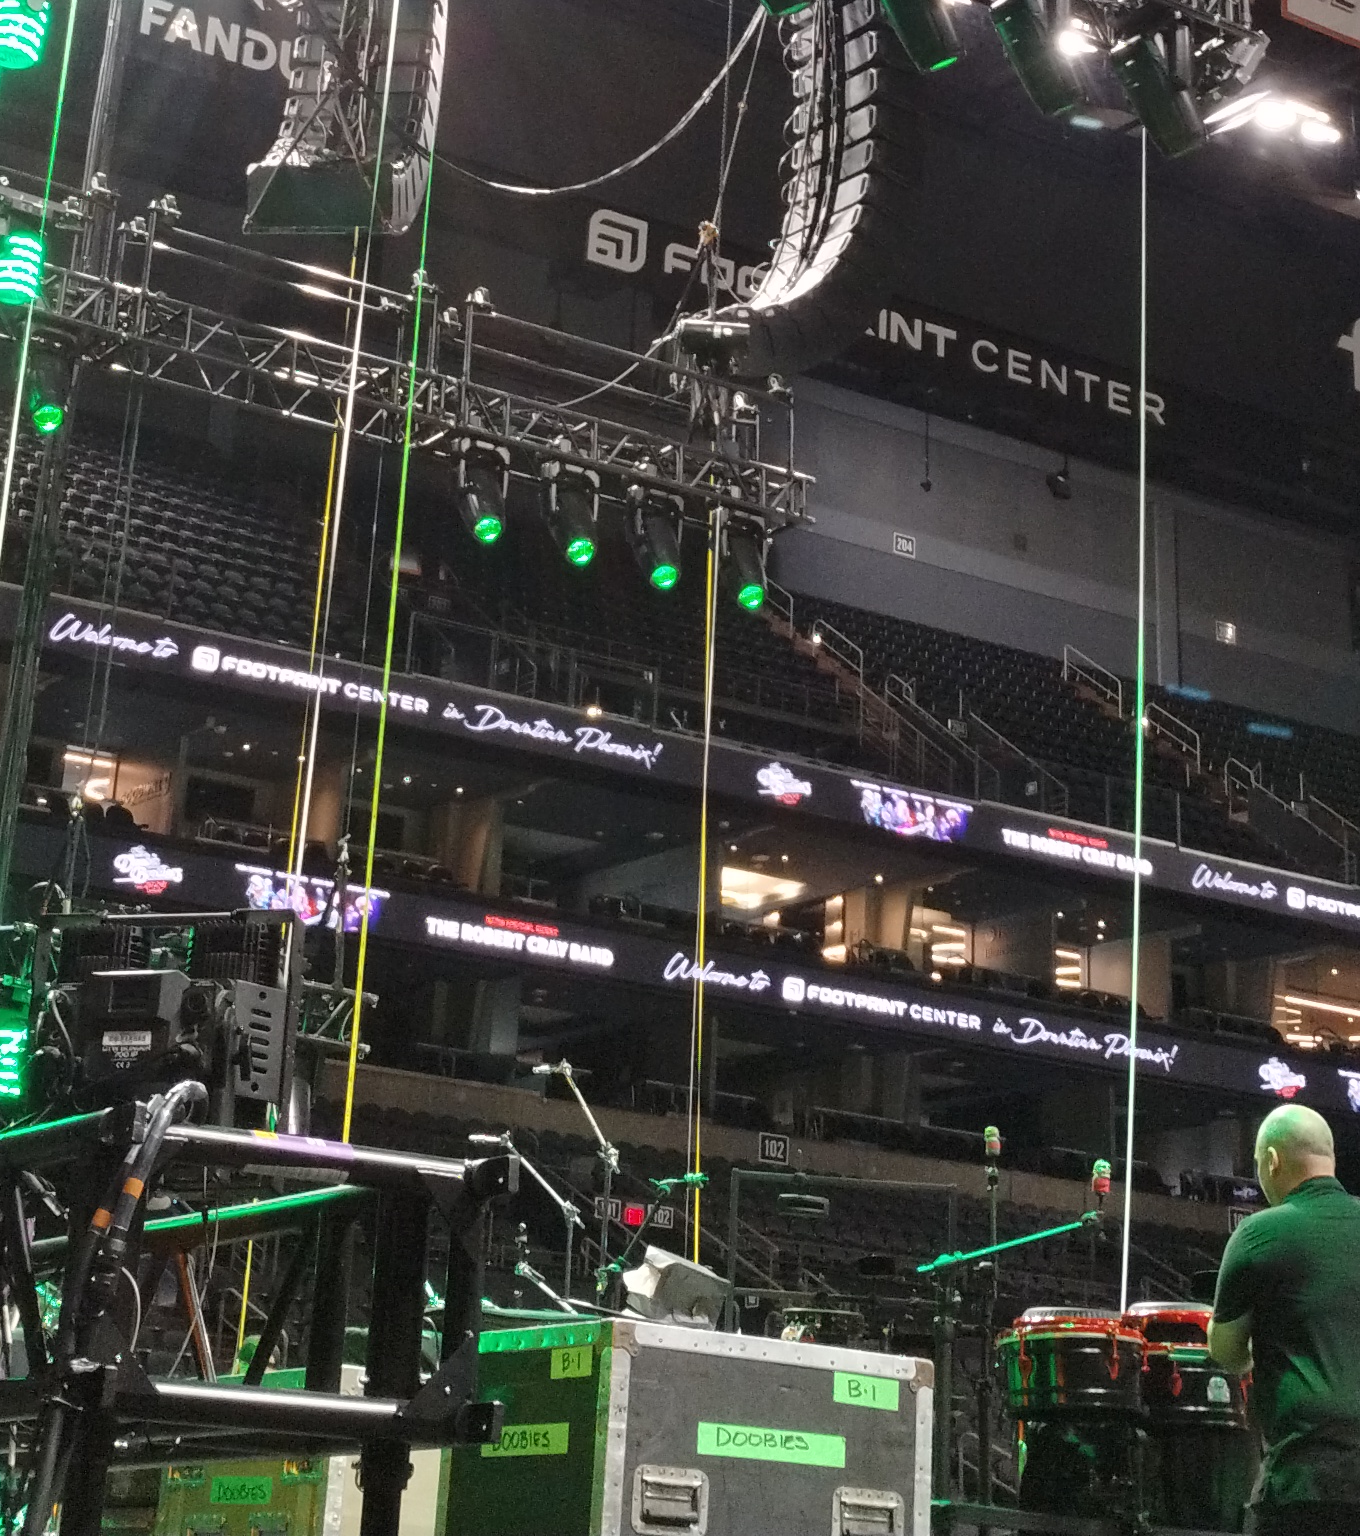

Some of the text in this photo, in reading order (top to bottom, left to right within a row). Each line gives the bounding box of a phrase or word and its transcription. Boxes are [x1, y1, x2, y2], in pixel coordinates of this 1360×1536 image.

[971, 339, 1166, 425] CENTER
[897, 537, 912, 552] 204
[49, 613, 154, 653] Welcome
[221, 655, 341, 695] FOOTPRINT
[343, 682, 429, 714] CENTER
[574, 727, 663, 770] Phoenix!
[1001, 828, 1030, 850] THE
[425, 916, 614, 966] THE ROBERT CRAY BAND
[806, 985, 908, 1016] FOOTPRINT
[909, 1003, 982, 1030] CENTER
[764, 1139, 785, 1158] 102
[716, 1427, 810, 1450] DOOBIES
